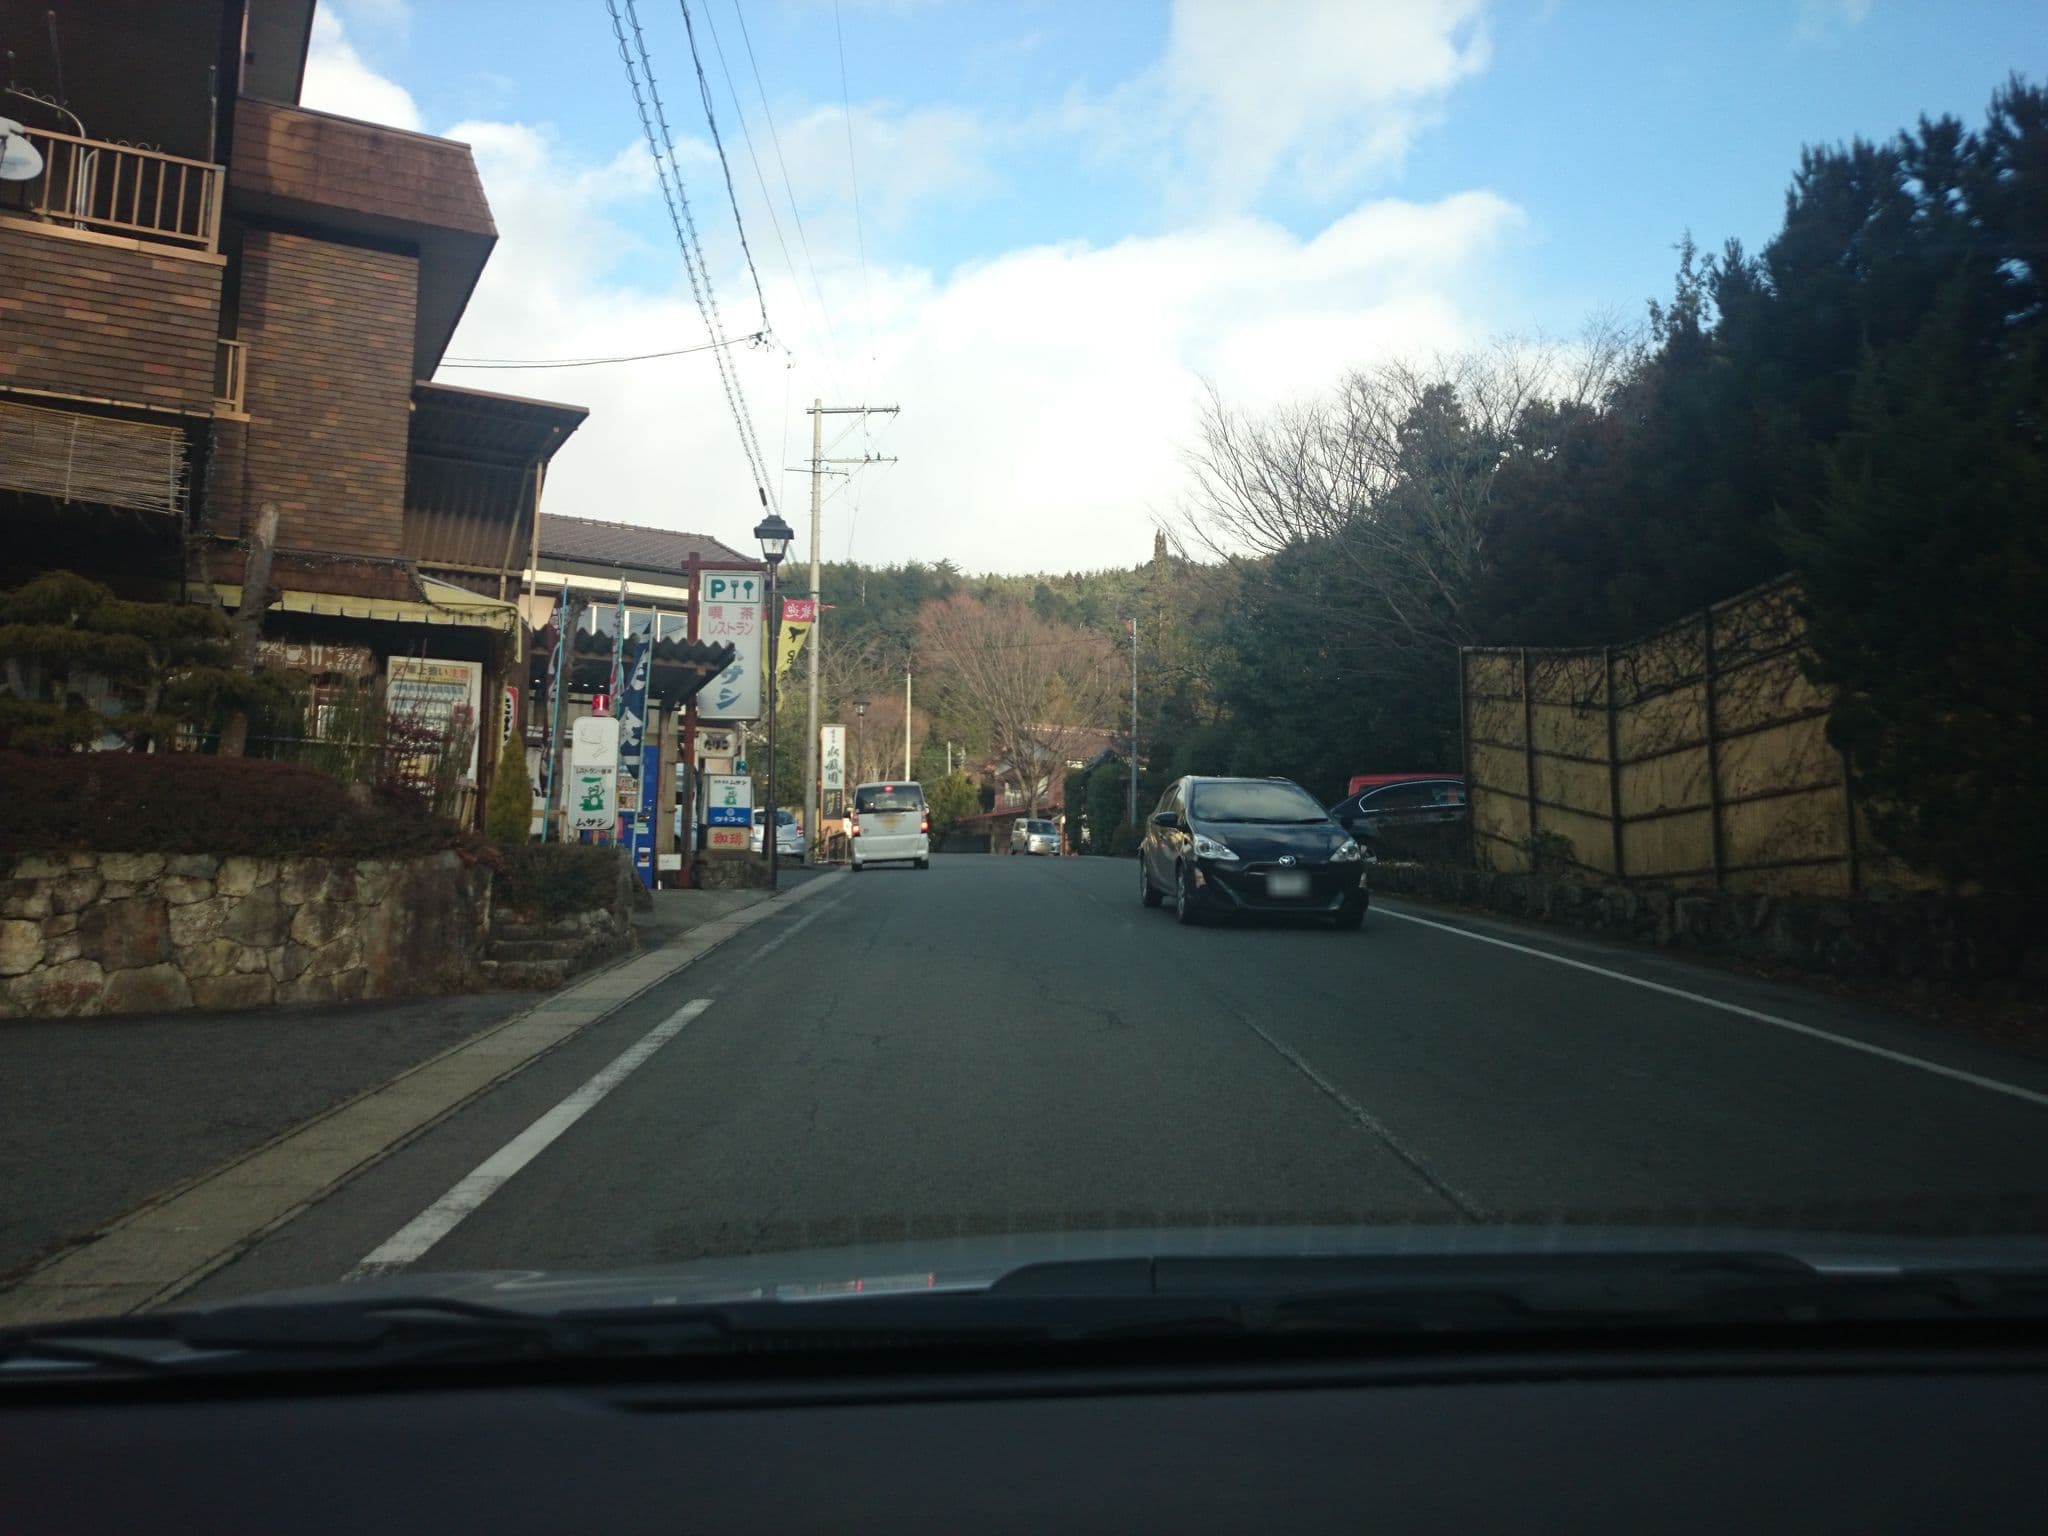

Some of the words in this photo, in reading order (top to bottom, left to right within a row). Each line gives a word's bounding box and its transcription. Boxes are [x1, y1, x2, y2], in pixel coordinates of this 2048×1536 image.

[711, 579, 726, 599] P
[708, 621, 753, 635] レストラン
[576, 818, 606, 827] ムサシ
